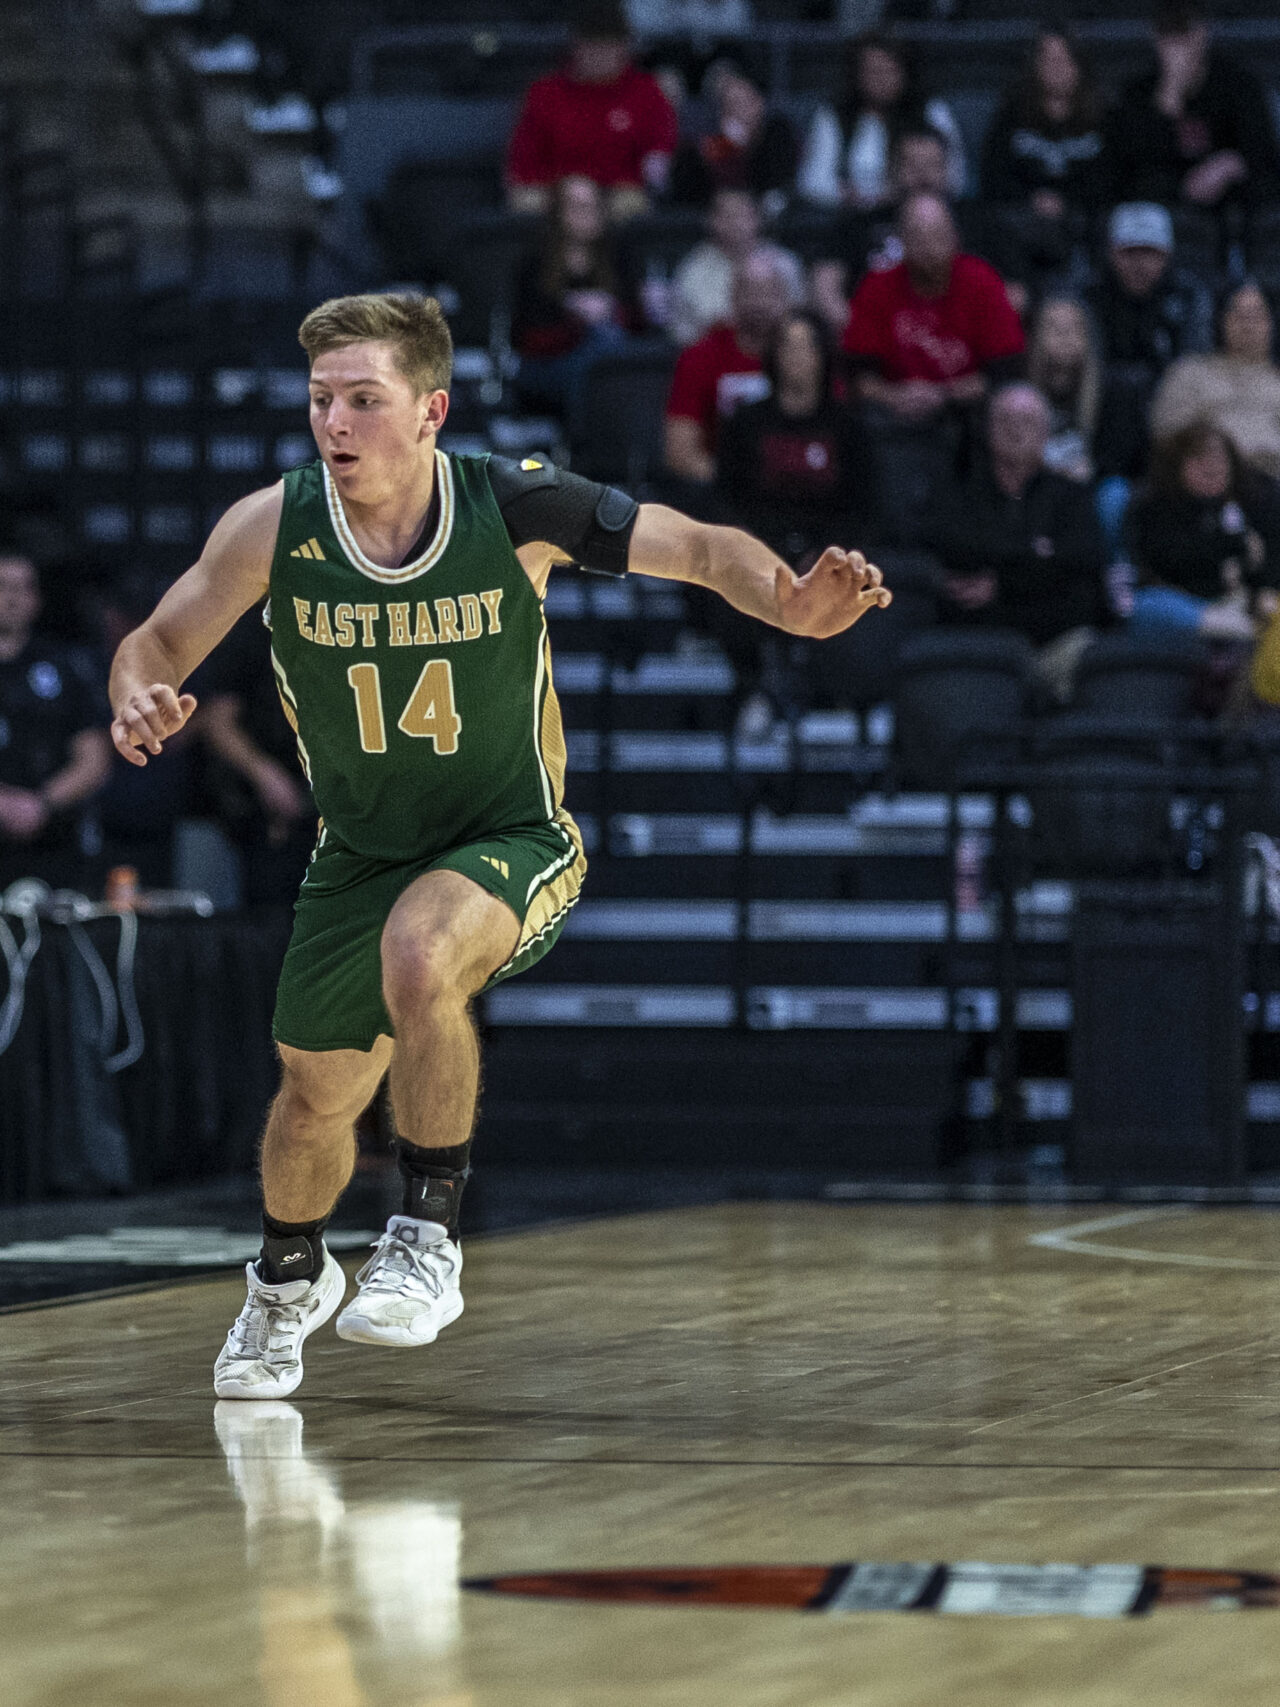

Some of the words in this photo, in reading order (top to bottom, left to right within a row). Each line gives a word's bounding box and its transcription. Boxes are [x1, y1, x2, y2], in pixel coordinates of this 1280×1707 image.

[293, 596, 380, 647] EAST
[387, 588, 503, 646] HARDY
[347, 658, 462, 755] 14
